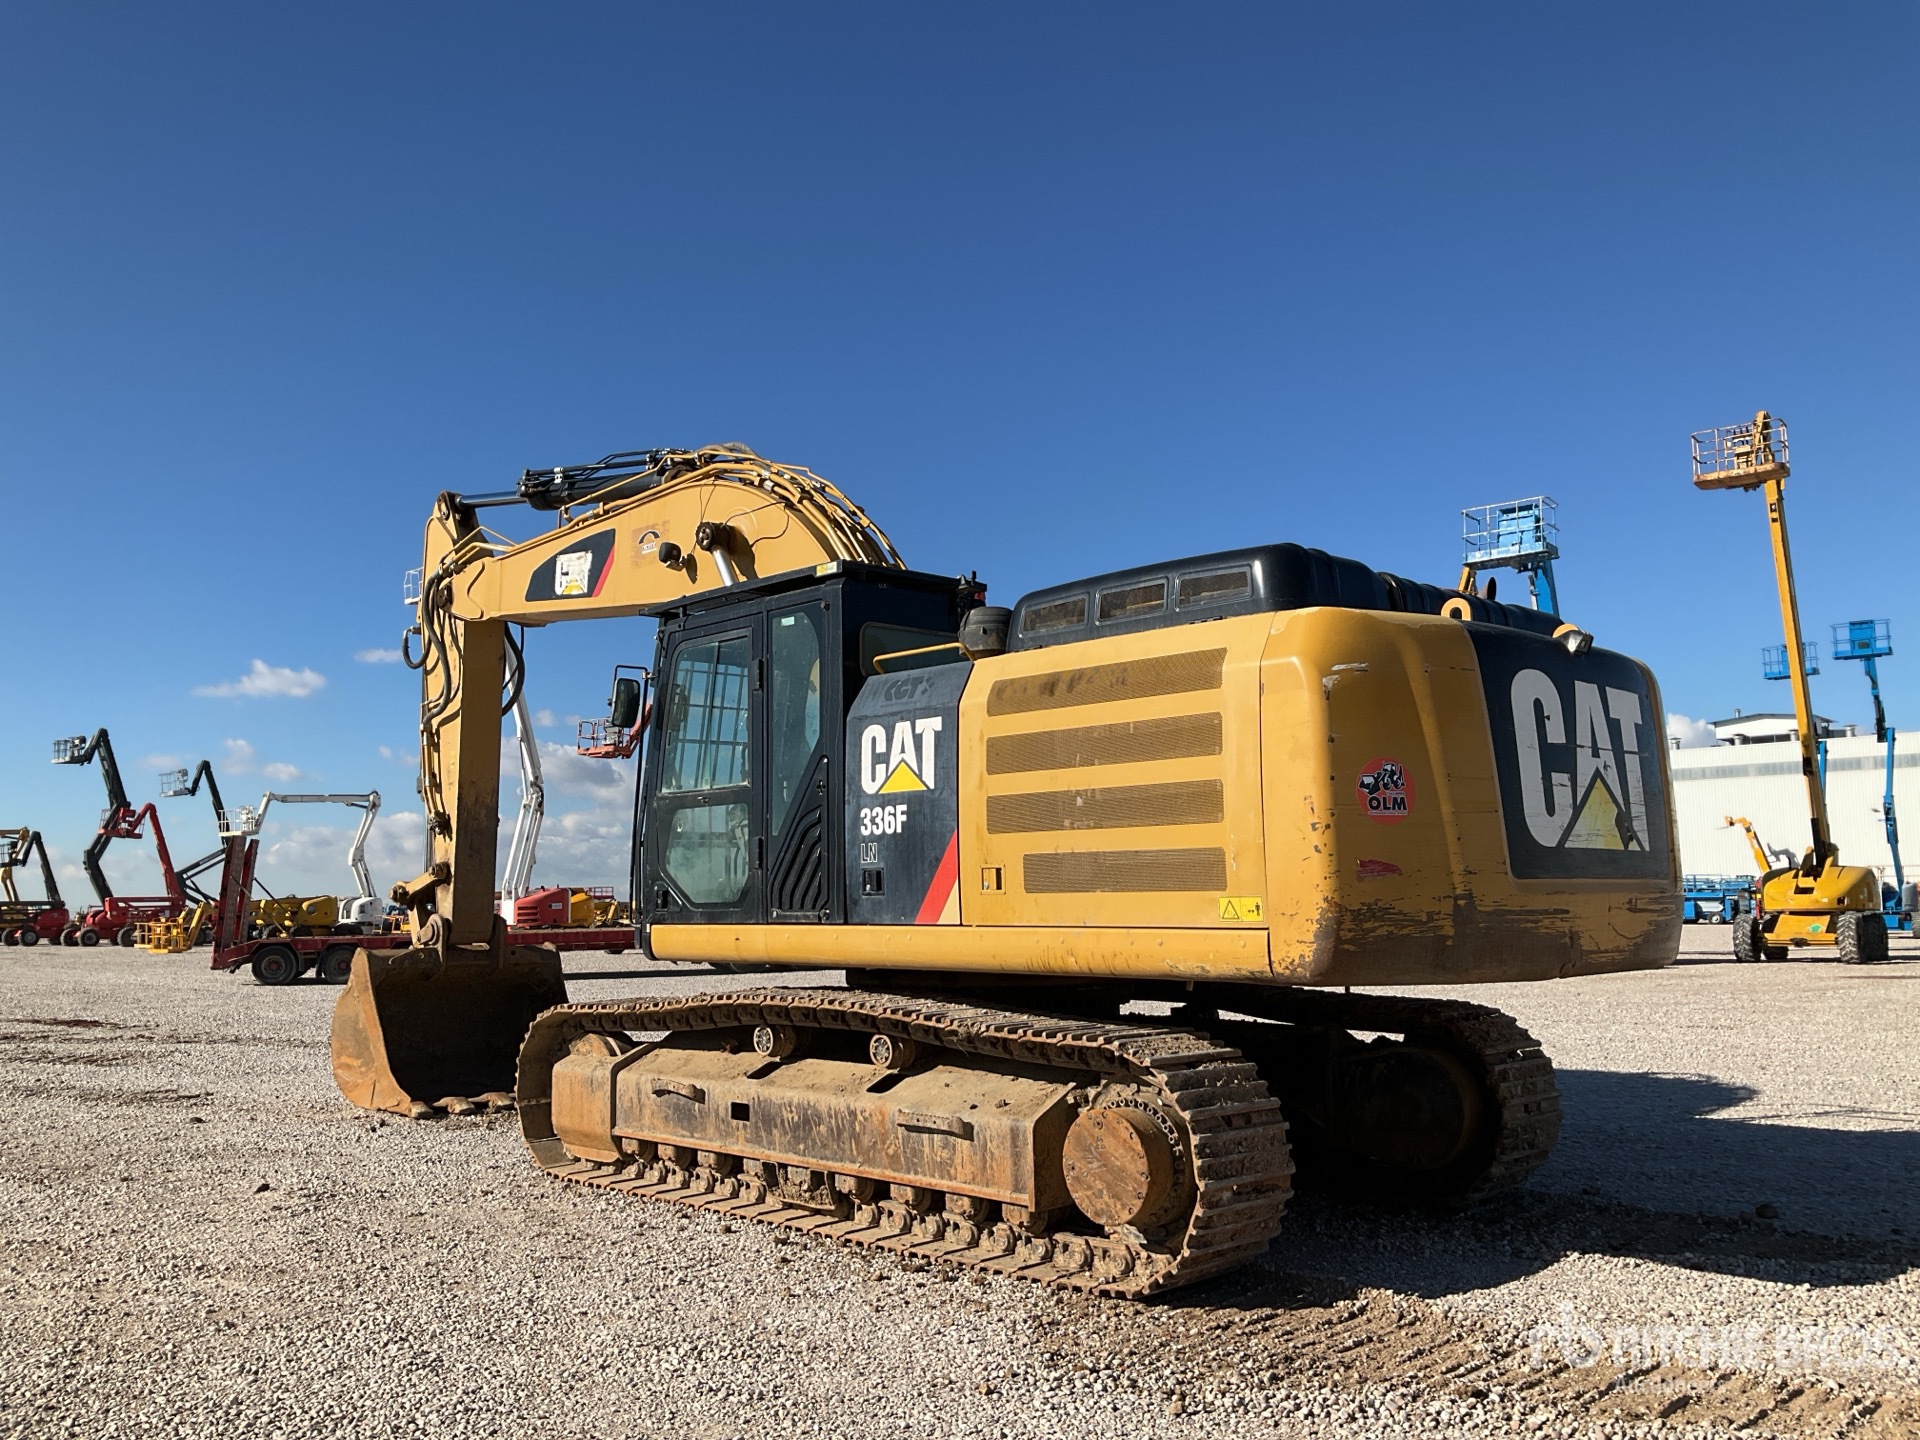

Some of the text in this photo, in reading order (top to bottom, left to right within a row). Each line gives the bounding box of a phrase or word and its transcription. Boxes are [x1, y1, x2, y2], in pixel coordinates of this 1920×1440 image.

[861, 716, 942, 795] CAT
[1511, 669, 1650, 851] CAT
[1368, 795, 1407, 811] OLM
[860, 804, 907, 835] 336F
[861, 842, 877, 863] LN
